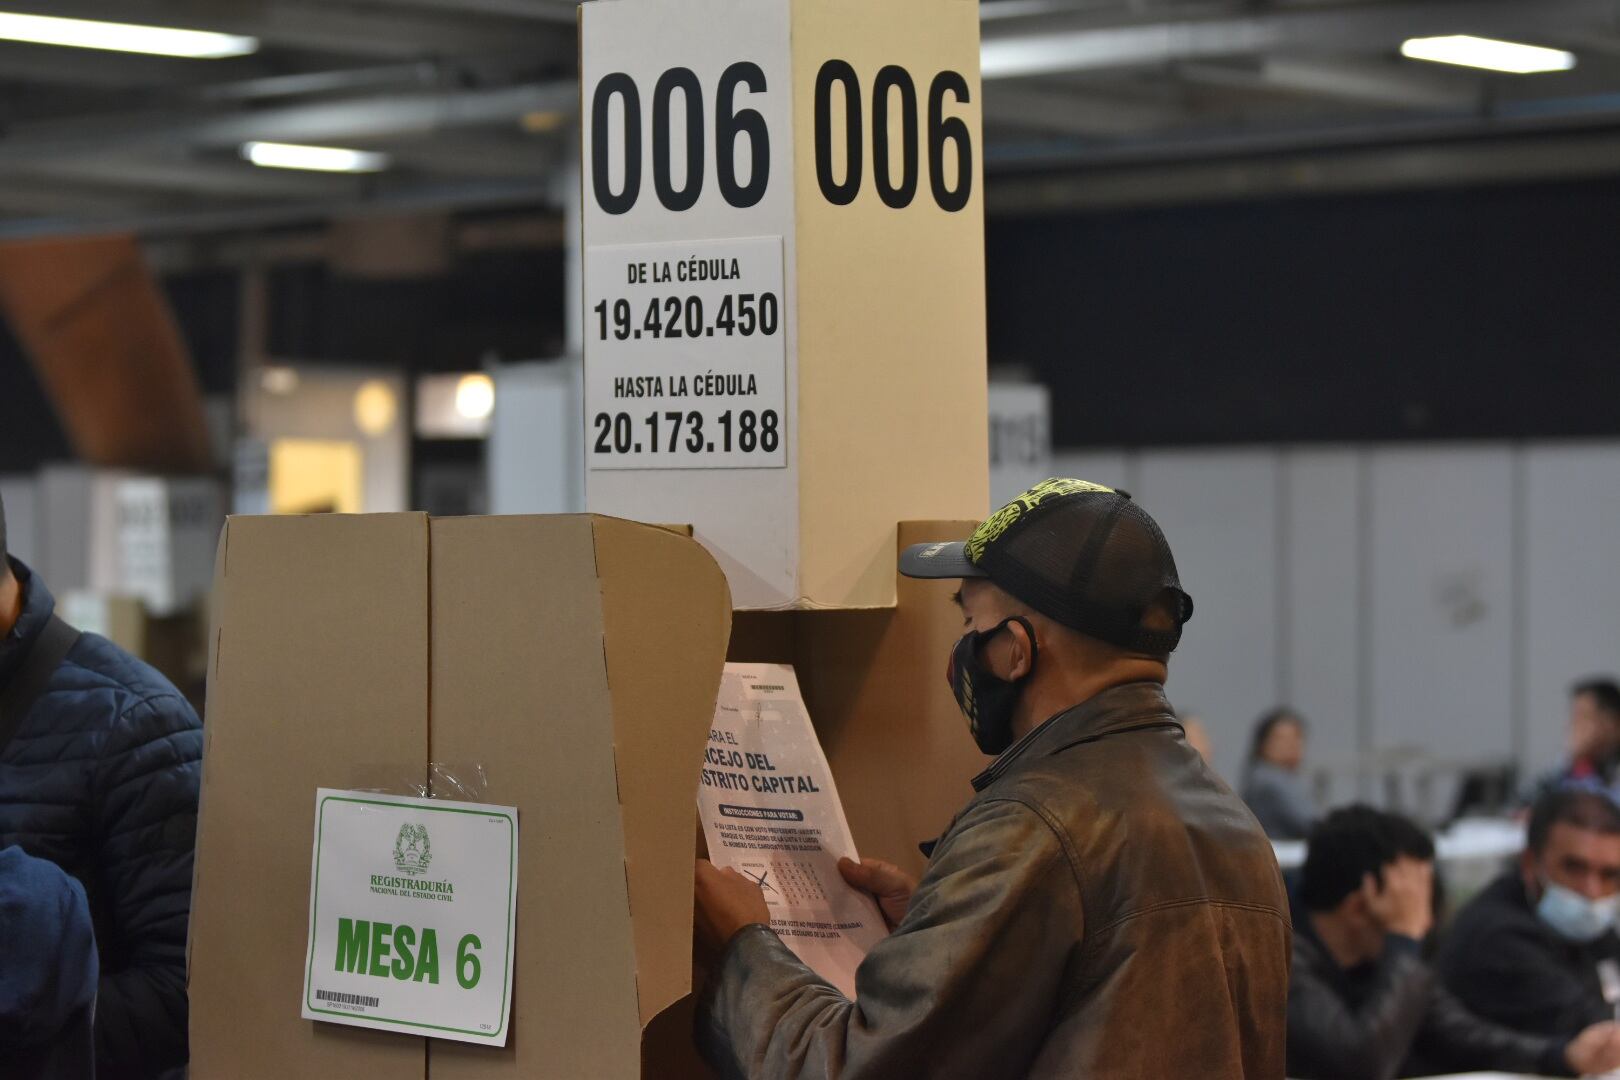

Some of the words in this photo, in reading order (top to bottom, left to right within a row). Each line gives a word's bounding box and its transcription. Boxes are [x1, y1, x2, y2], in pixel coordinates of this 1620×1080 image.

[591, 61, 770, 215] 006
[814, 58, 972, 213] 006
[627, 262, 648, 284] DE
[652, 261, 672, 283] LA
[677, 255, 741, 283] CÉDULA
[593, 292, 778, 341] 19.420.450
[614, 374, 664, 398] HASTA
[668, 374, 689, 397] LA
[693, 369, 757, 396] CÉDULA
[593, 409, 779, 454] 20.173.188
[707, 729, 725, 744] ARA
[725, 731, 739, 745] EL
[704, 746, 743, 768] NCEJO
[745, 752, 776, 771] DEL
[701, 768, 749, 791] ISTRITO
[751, 774, 819, 793] CAPITAL
[723, 807, 763, 818] INSTRUCCIONES
[763, 811, 778, 819] PARA
[369, 886, 398, 896] NACIONAL
[399, 889, 411, 897] DEL
[412, 892, 436, 900] ESTADO
[437, 894, 454, 902] CIVIL
[370, 874, 454, 894] REGISTRADURÍA
[334, 917, 440, 985] MESA
[455, 933, 482, 990] 6
